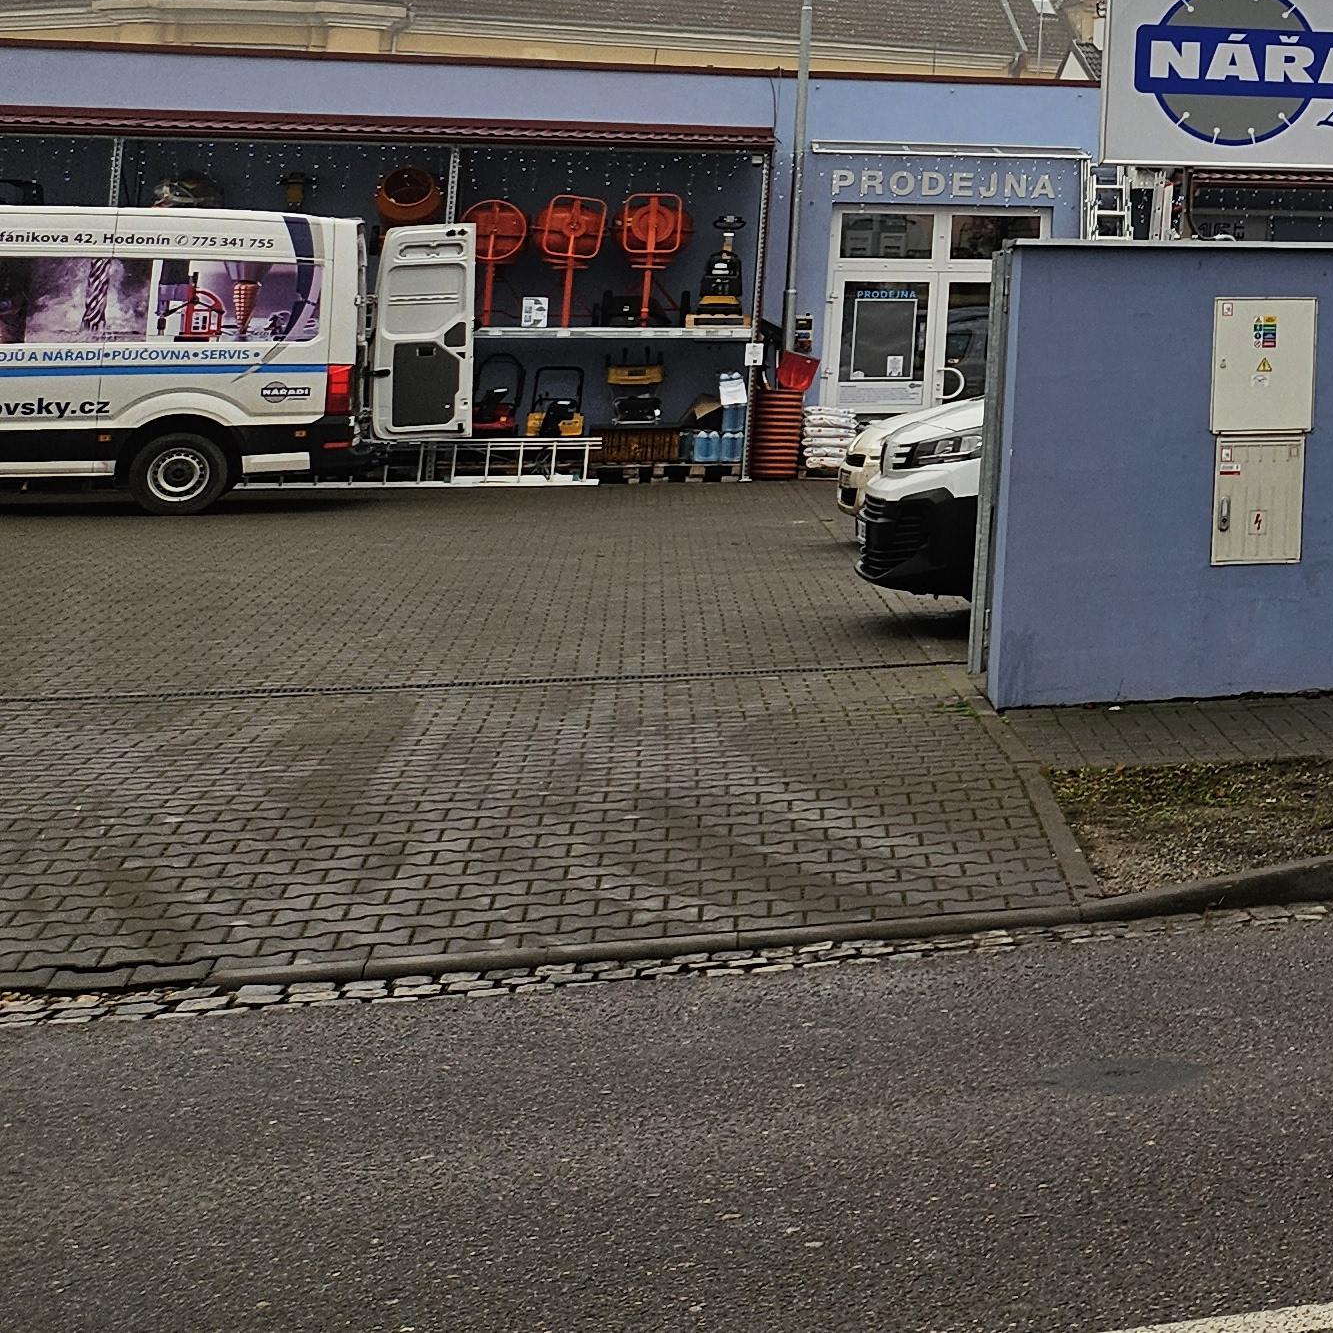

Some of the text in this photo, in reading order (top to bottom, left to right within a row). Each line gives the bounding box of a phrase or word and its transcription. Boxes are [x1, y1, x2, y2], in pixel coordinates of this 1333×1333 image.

[831, 168, 1056, 199] PRODEJNA
[0, 231, 274, 249] fánikova 42, Hodonín 775 341 755
[856, 290, 917, 299] PRODEJNA
[28, 351, 39, 362] A
[42, 348, 101, 362] NÁŘADÍ
[111, 348, 191, 362] PŮJČOVNA
[200, 349, 250, 361] SERVIS
[0, 397, 111, 419] vsky.cz
